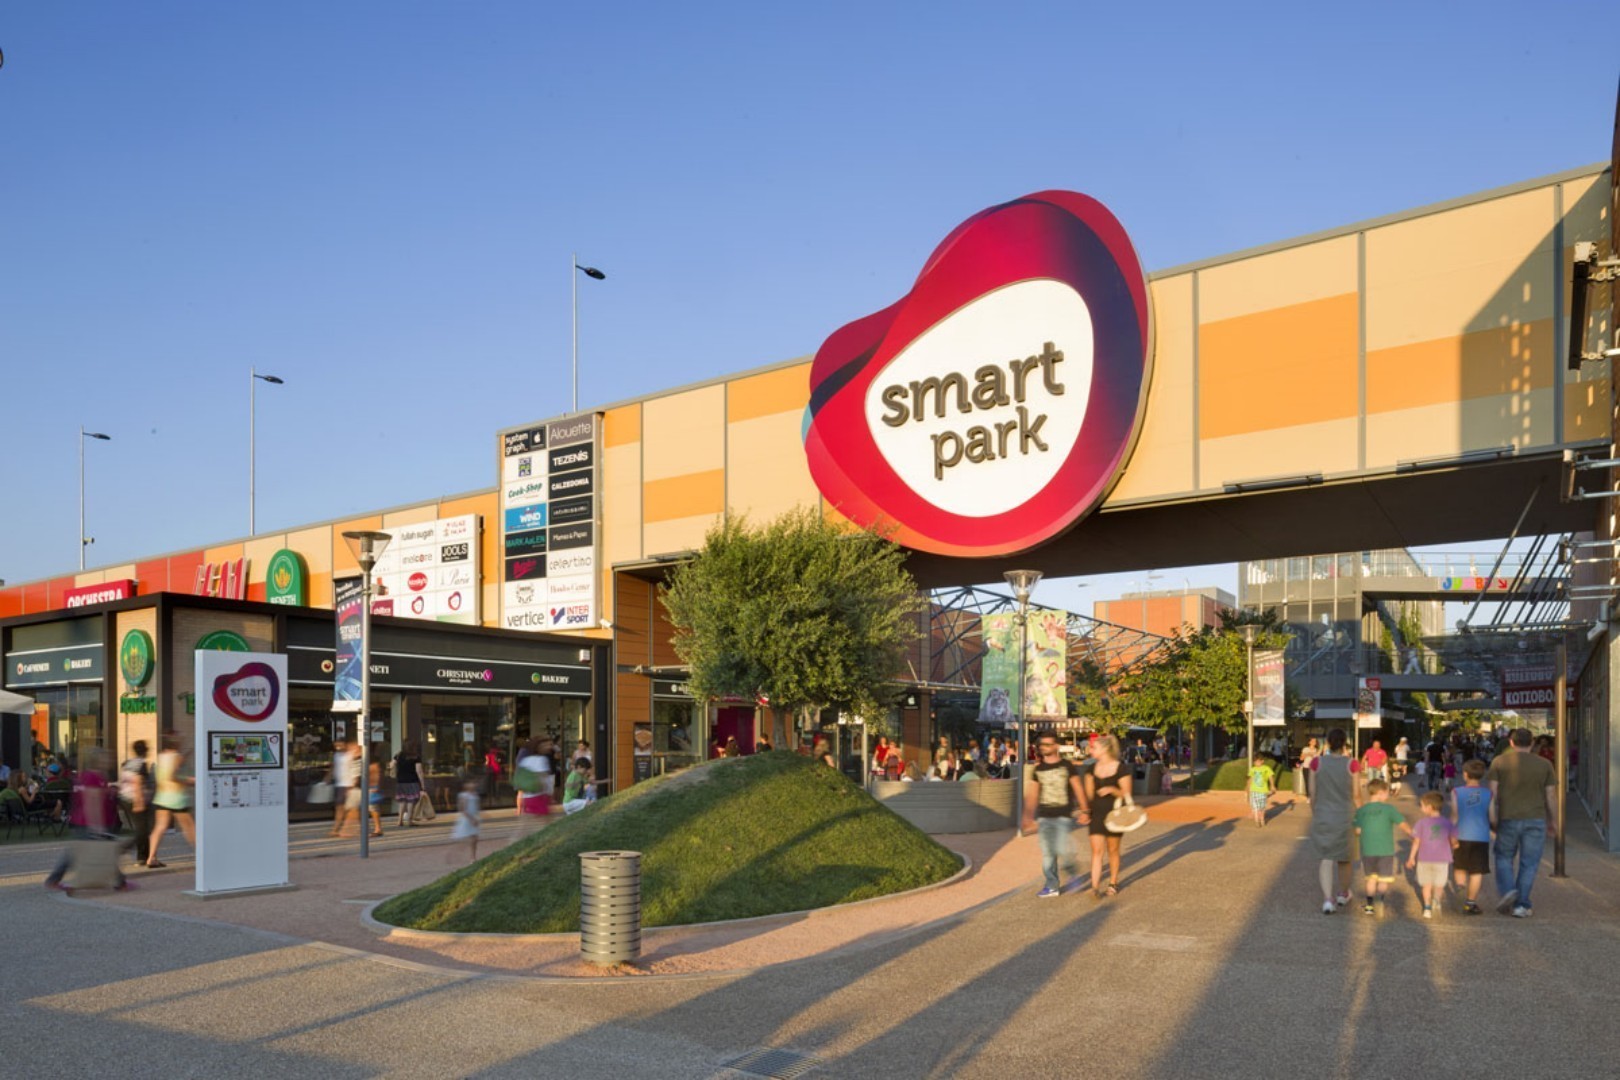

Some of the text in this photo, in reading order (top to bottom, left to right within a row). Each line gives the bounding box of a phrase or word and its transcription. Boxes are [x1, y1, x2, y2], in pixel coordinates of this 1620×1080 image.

[881, 342, 1065, 427] smart
[551, 422, 592, 440] Alouette
[930, 406, 1049, 480] park
[552, 450, 588, 466] TEZENIS
[551, 478, 590, 491] CALZEDONIA
[442, 544, 467, 557] JOOLS
[566, 605, 589, 615] INTER
[507, 611, 545, 627] vertice
[566, 614, 589, 624] SPORT
[436, 668, 483, 680] CHRISTIANO
[541, 674, 570, 684] BAKERY
[230, 687, 266, 697] smart
[1504, 687, 1575, 705] ΚΩΤΣΟΒΟΣ
[241, 696, 264, 708] park
